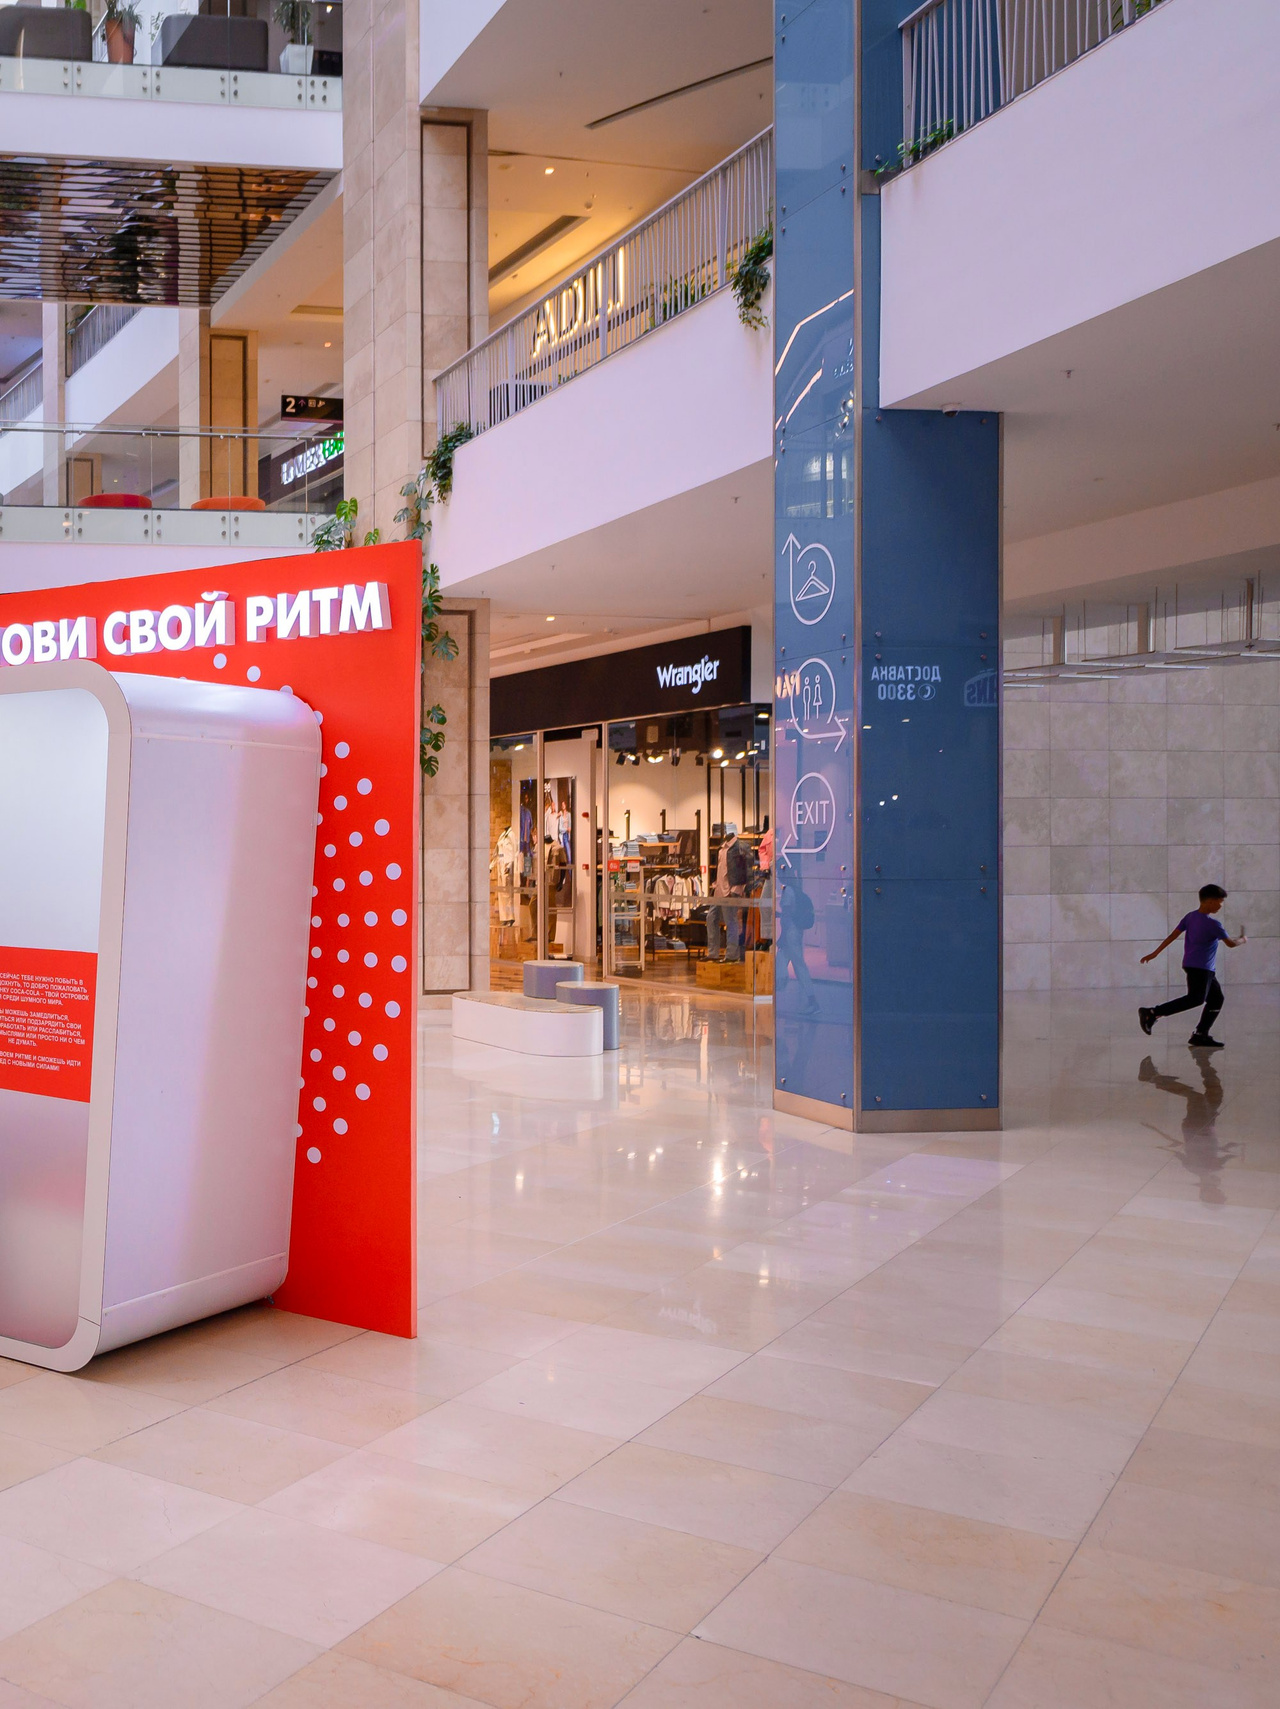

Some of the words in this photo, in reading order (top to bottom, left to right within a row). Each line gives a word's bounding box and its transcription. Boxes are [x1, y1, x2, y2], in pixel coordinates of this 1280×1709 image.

[285, 398, 296, 413] 2
[103, 591, 228, 656] СВОЙ
[246, 581, 387, 643] РИТМ
[656, 657, 720, 694] Wrangler
[795, 800, 830, 825] EXIT
[50, 984, 87, 993] ПОЖАЛОВАТЬ
